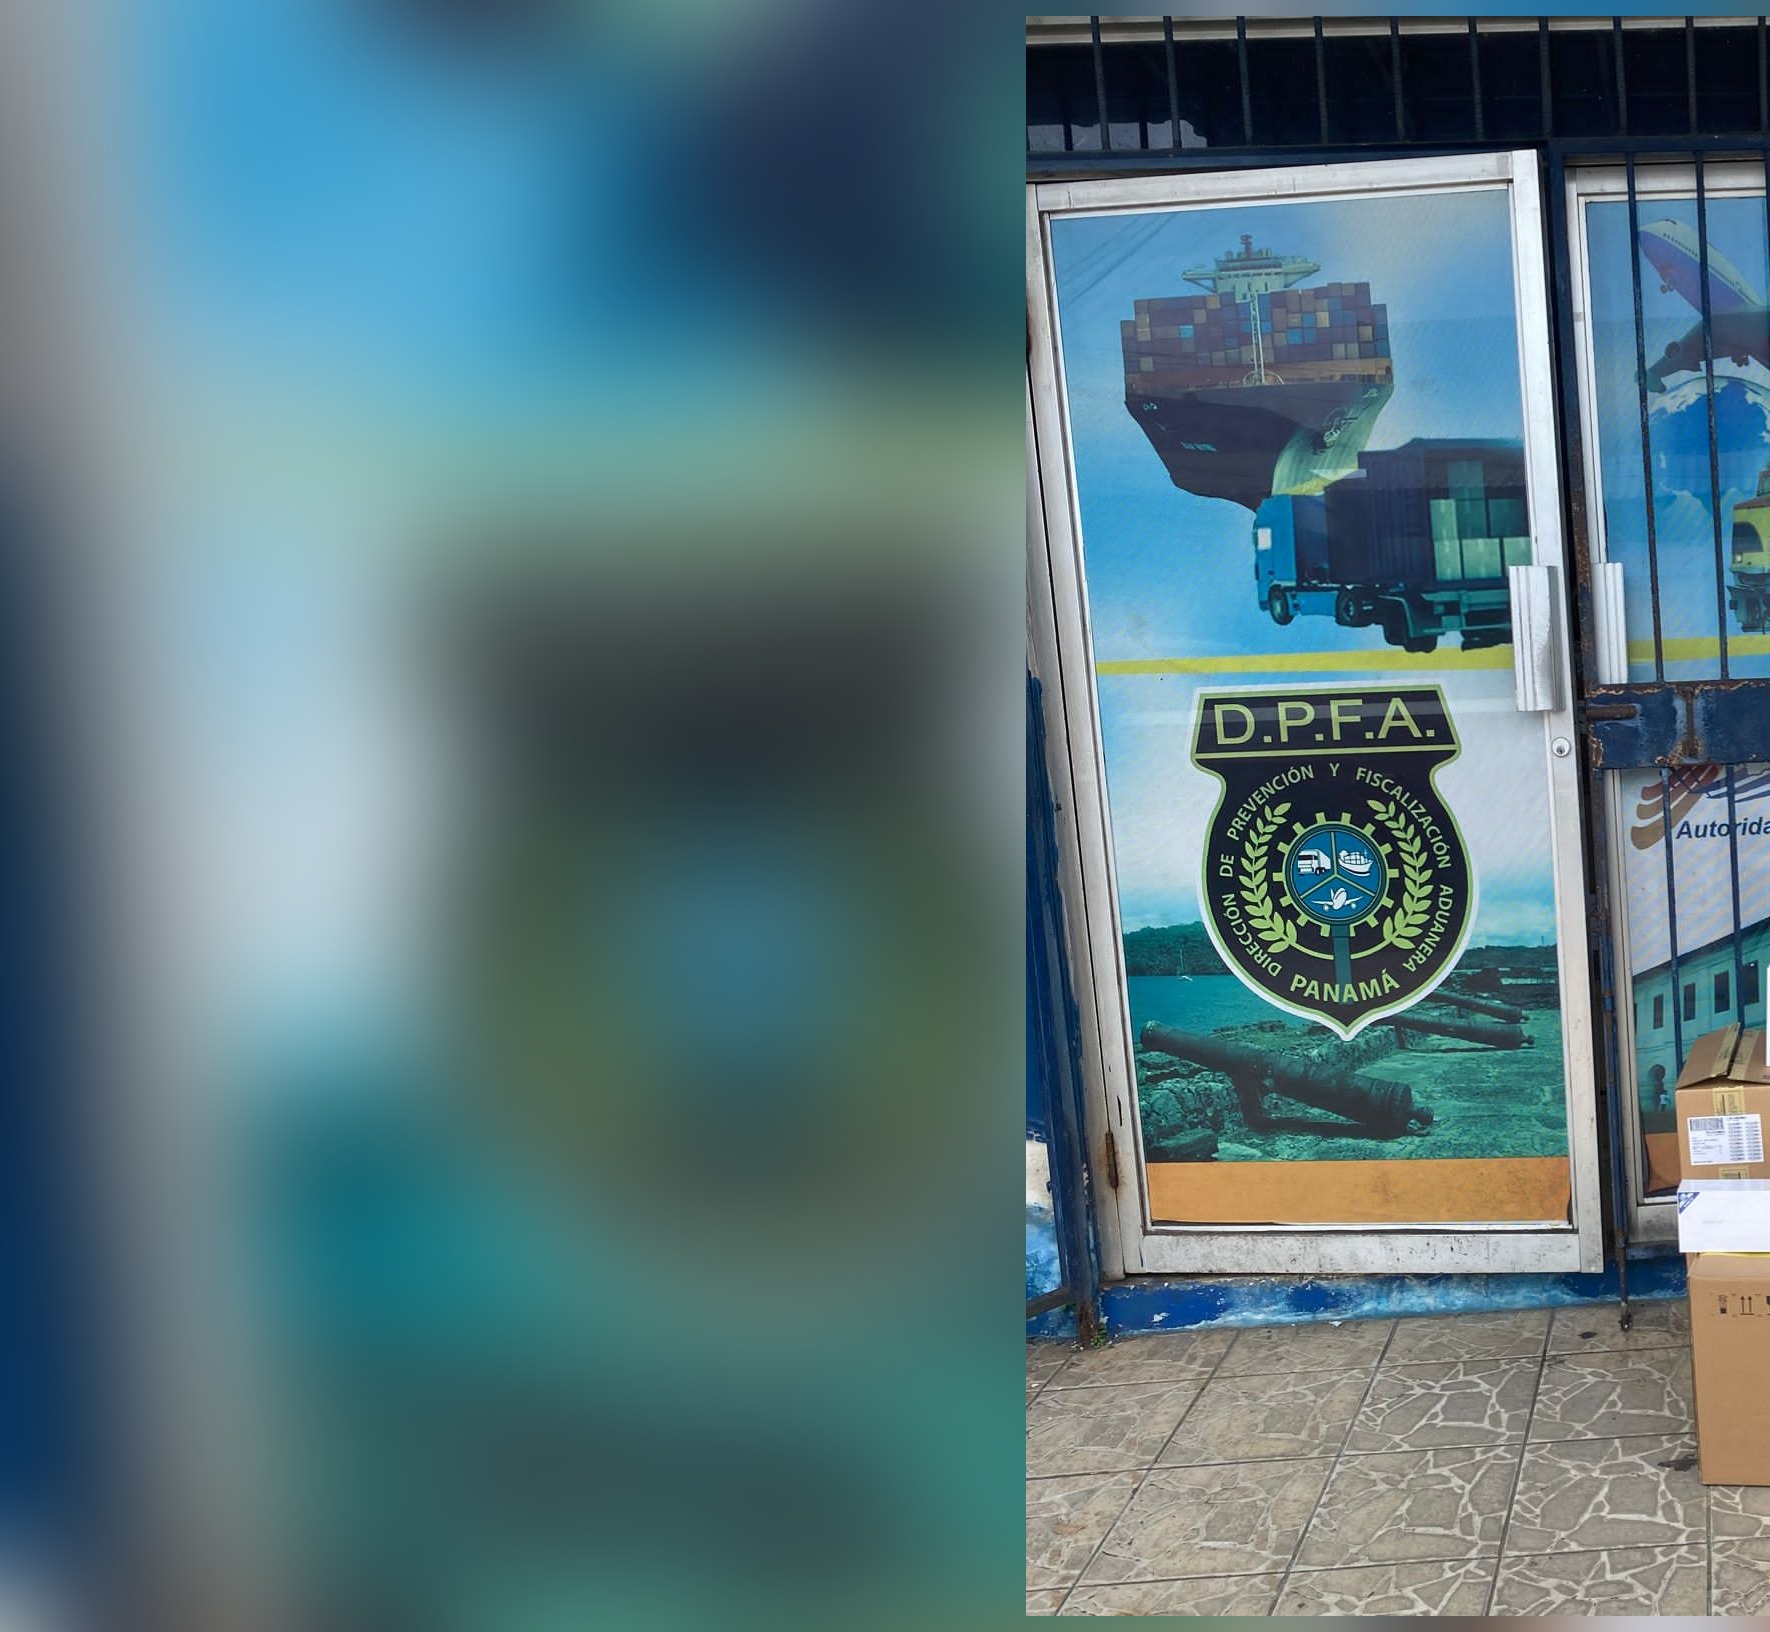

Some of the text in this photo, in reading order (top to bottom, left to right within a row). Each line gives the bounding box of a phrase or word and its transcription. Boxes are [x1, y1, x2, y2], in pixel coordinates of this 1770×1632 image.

[1214, 697, 1435, 745] D.P.F.A.
[1220, 763, 1454, 977] DIRECCIÓN DE PREVENCIÓN Y FISCALIZACIÓN ADUANERA
[1290, 969, 1401, 1003] PANAMÁ
